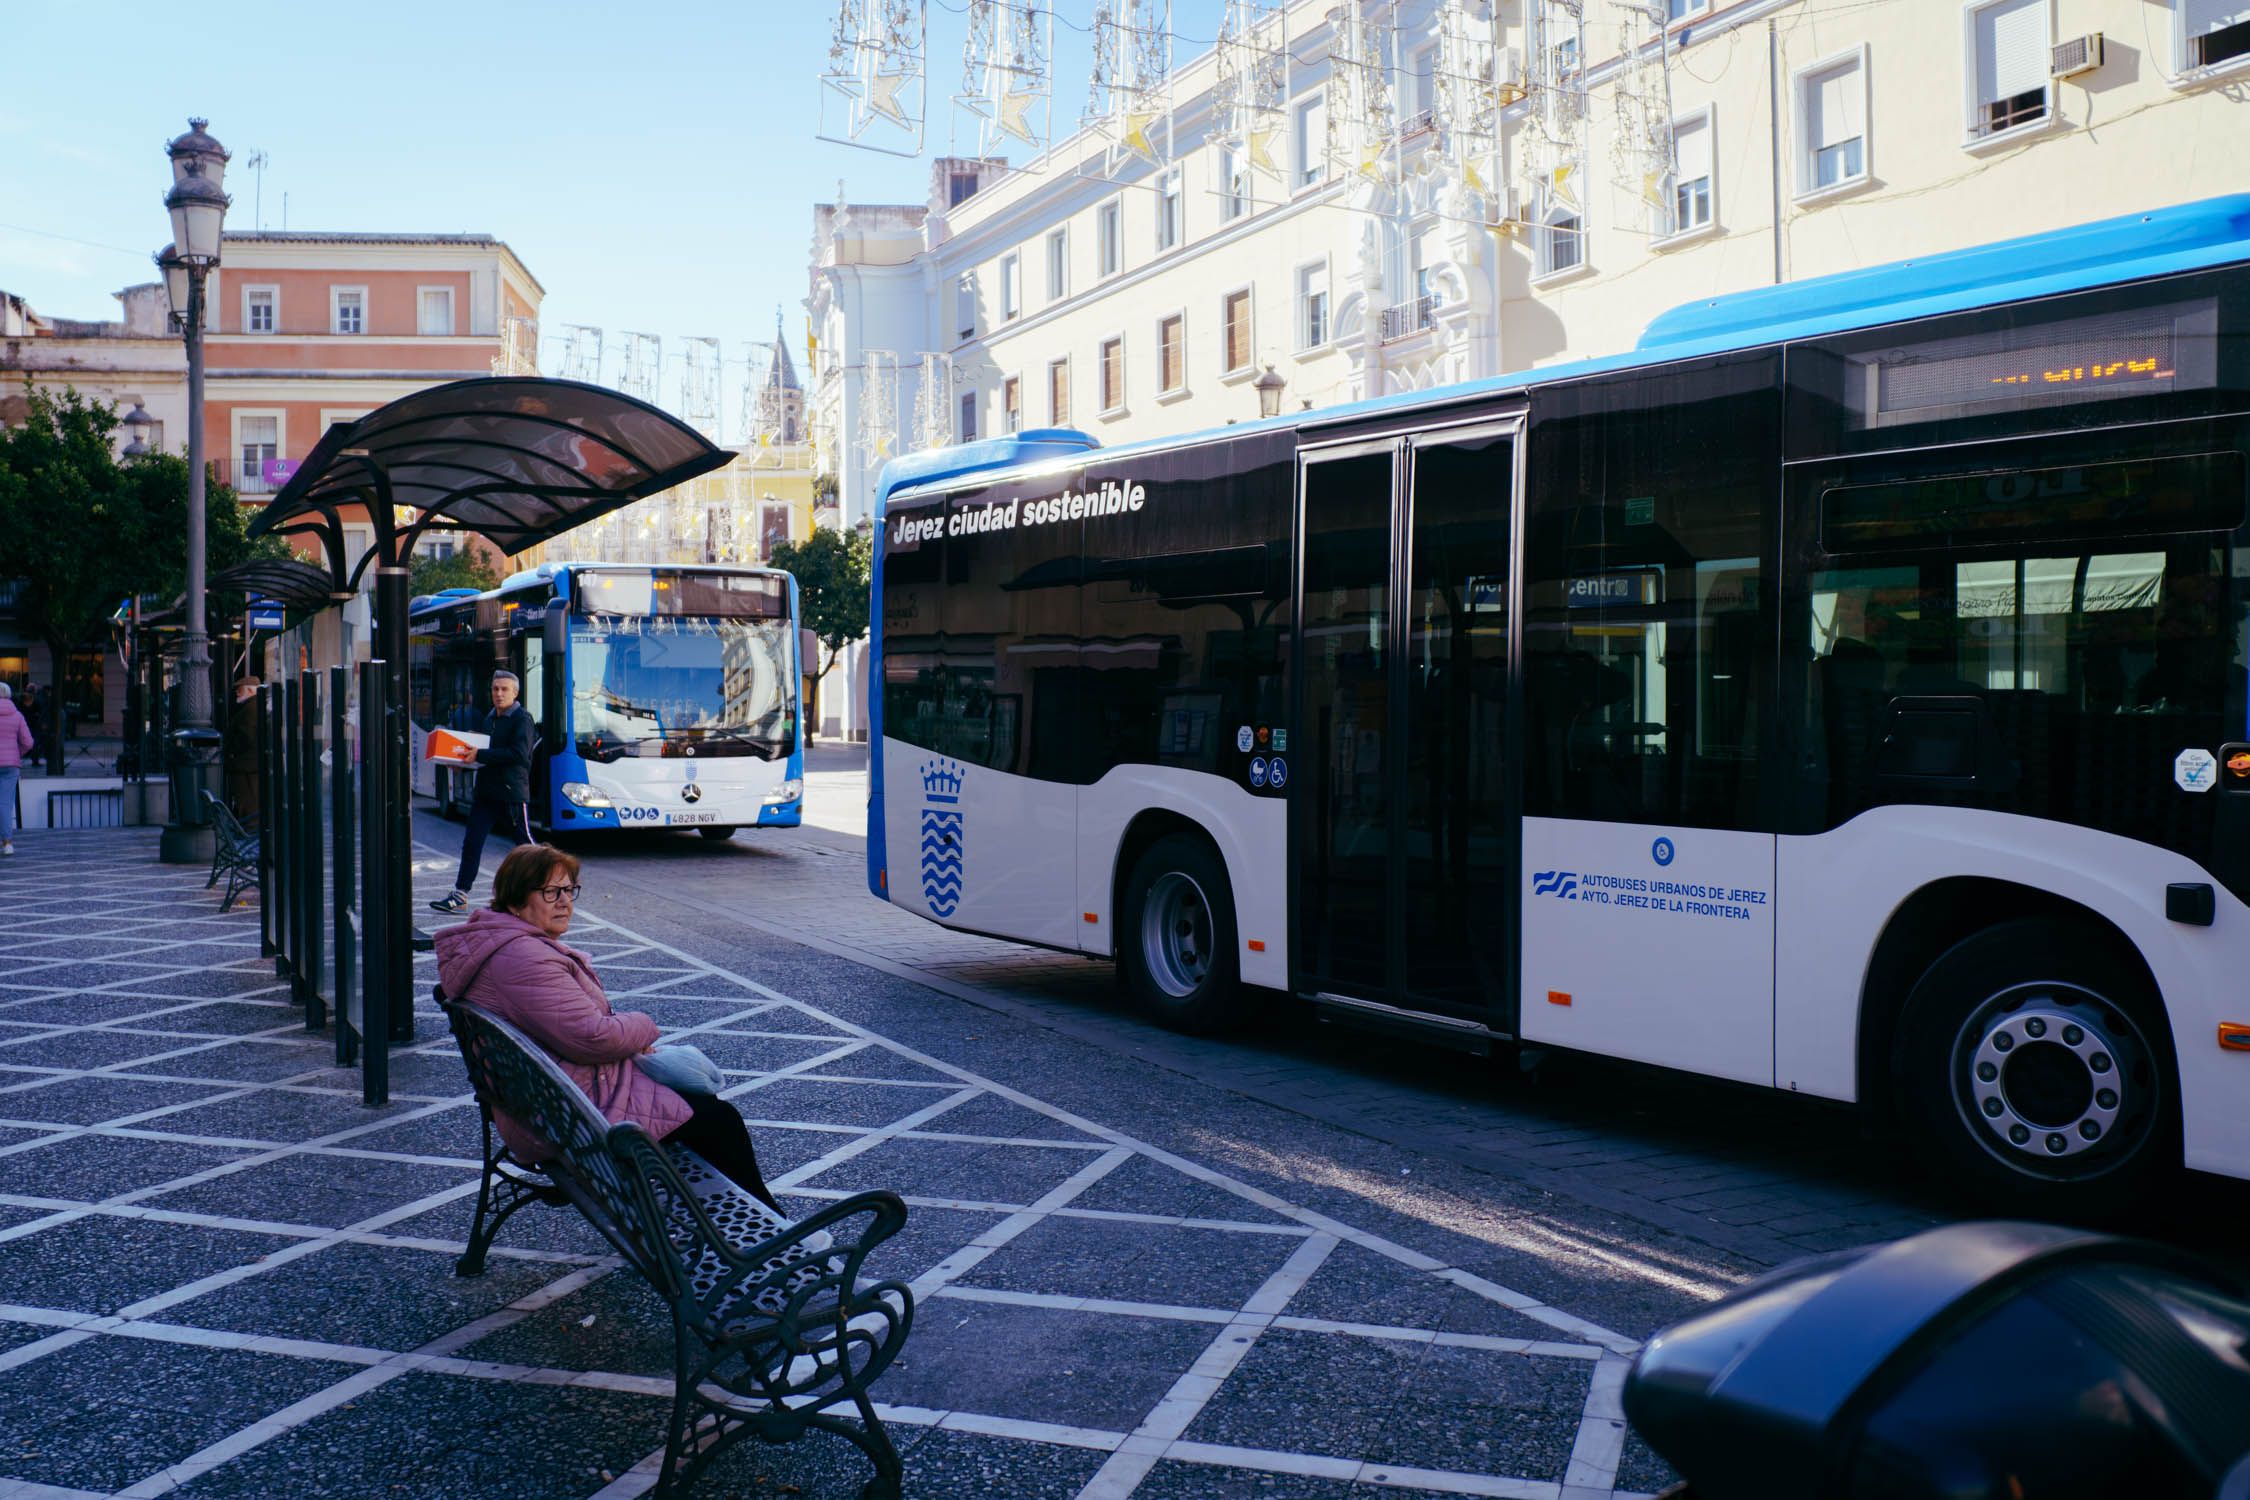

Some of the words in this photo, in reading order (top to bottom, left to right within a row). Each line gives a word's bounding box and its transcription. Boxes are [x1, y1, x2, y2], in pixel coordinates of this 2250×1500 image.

[893, 515, 944, 545] Jerez
[948, 497, 1019, 537] ciudad
[1022, 479, 1146, 527] sostenible
[672, 813, 696, 823] 4828
[1582, 874, 1647, 892] AUTOBUSES
[1650, 881, 1707, 898] URBANOS
[1708, 887, 1725, 900] DE
[1727, 889, 1766, 904] JEREZ
[1582, 890, 1612, 904] AYTO.
[1614, 894, 1648, 908] JEREZ
[1651, 897, 1666, 910] DE
[1669, 900, 1684, 913] LA
[1686, 901, 1750, 920] FRONTERA
